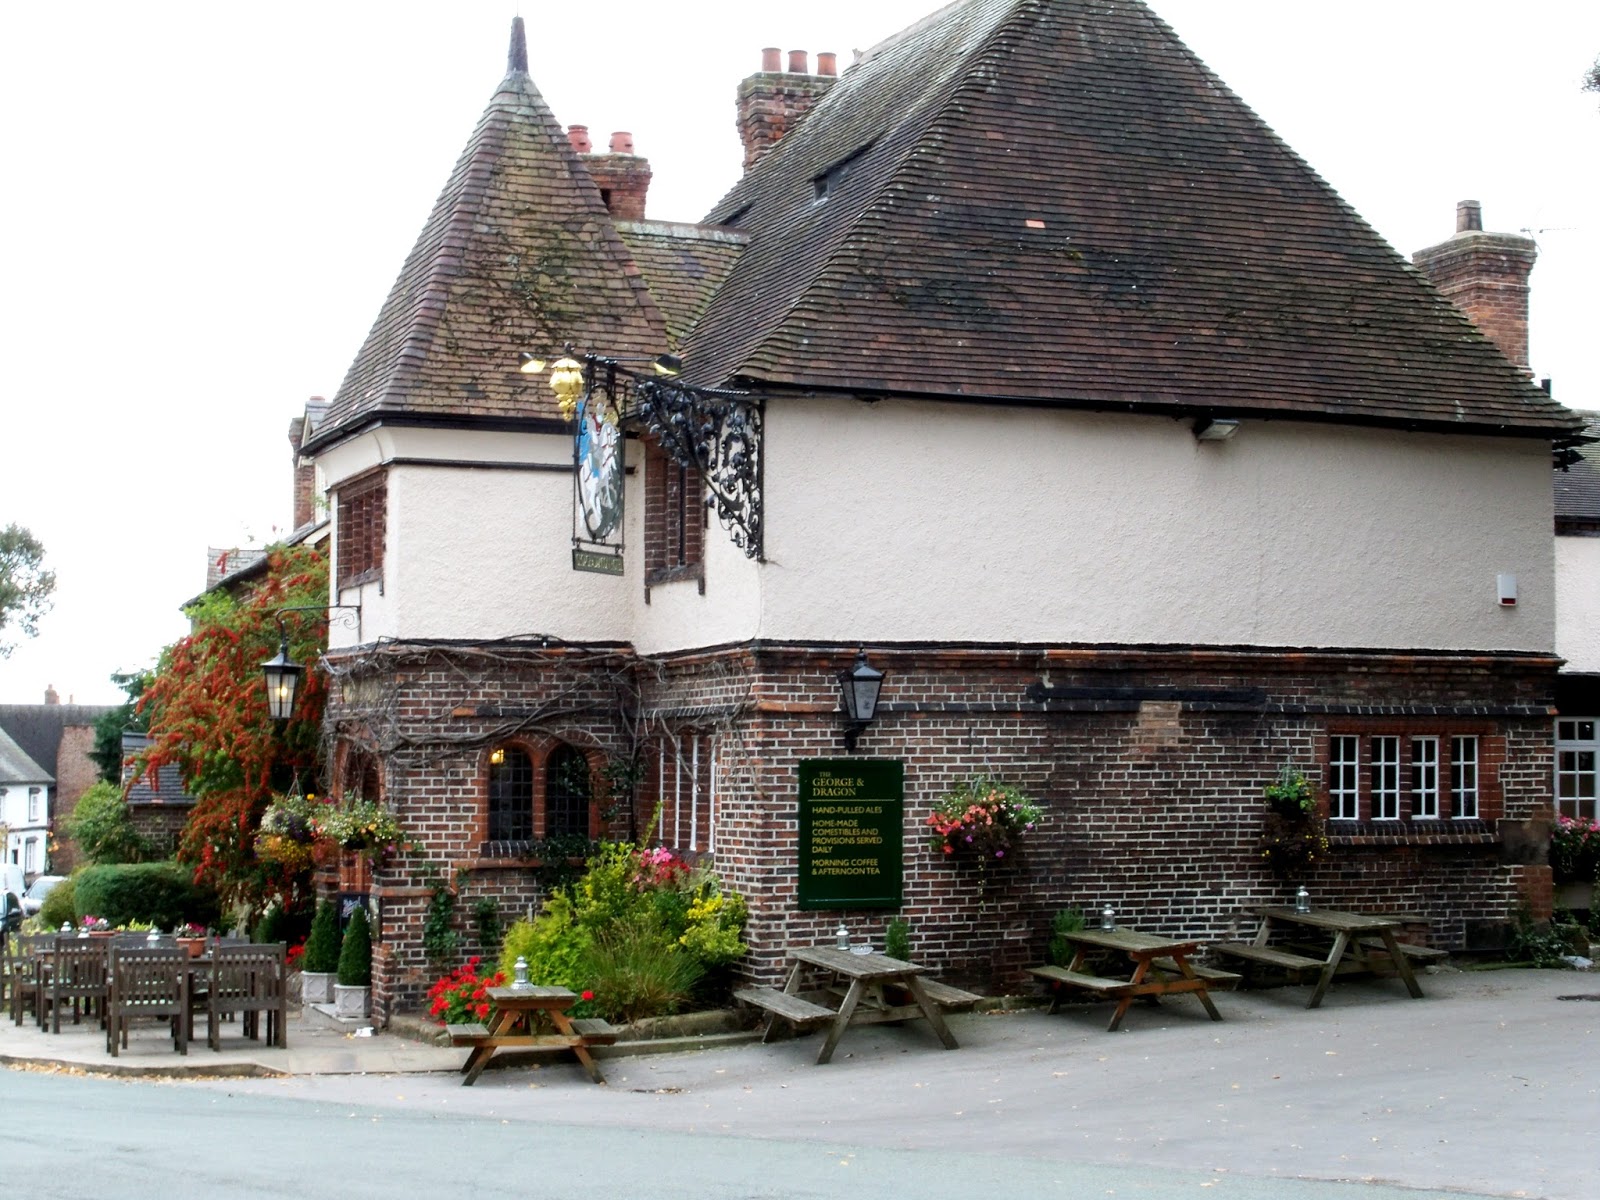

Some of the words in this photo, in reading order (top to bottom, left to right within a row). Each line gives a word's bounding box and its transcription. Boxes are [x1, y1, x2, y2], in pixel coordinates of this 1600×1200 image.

[812, 778, 854, 787] GEORGE
[857, 778, 865, 787] &
[812, 787, 856, 796] DRAGON
[865, 806, 882, 814] ALES
[812, 828, 860, 836] COMESTIBLES
[818, 867, 866, 875] AFTERNOON
[867, 867, 880, 875] TEA
